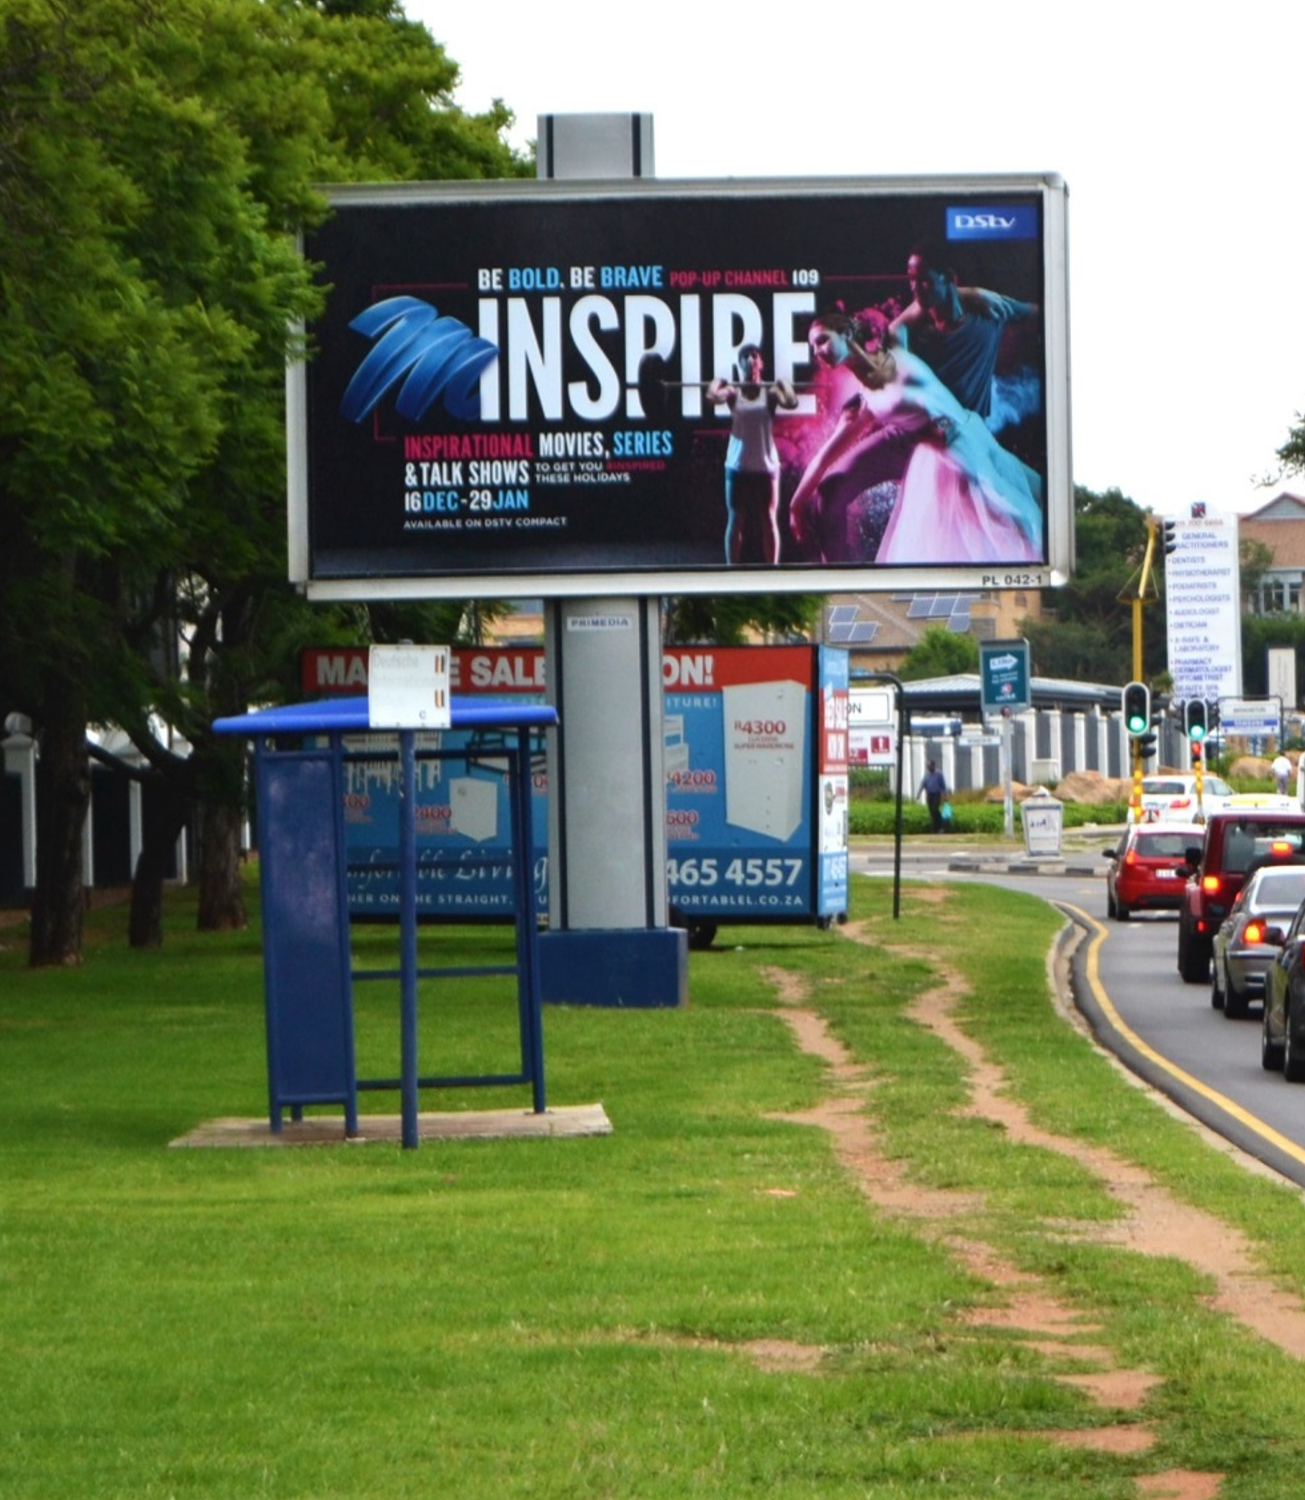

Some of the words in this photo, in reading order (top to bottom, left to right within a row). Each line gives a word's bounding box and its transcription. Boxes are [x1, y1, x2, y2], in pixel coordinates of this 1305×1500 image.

[478, 267, 503, 291] BE
[508, 267, 565, 290] BOLD.
[570, 266, 595, 289] BE
[601, 265, 663, 288] BRAVE
[670, 270, 722, 287] POP-UP
[725, 269, 788, 286] CHANNEL
[792, 269, 819, 286] 109
[478, 292, 817, 423] INSPIRE
[404, 434, 534, 460] INSPIRATIONAL
[539, 431, 610, 459] MOVIES,
[613, 430, 673, 456] SERIES
[469, 460, 530, 485] SHOWS
[535, 462, 550, 472] TO
[553, 461, 575, 472] GET
[579, 461, 603, 472] YOU
[535, 473, 570, 483] THESE
[573, 472, 630, 483] HOLIDAYS
[404, 519, 462, 529] AVAILABLE
[465, 519, 481, 528] ON
[484, 518, 512, 527] DSTV
[515, 517, 567, 527] COMPACT
[1176, 541, 1229, 549] RACTITIONERS
[982, 575, 999, 586] PL
[1004, 574, 1042, 586] 042-1
[570, 618, 629, 628] PRIMEDIA
[666, 697, 717, 708] ITURE!
[734, 720, 786, 735] R4300
[667, 771, 714, 786] 4200
[413, 807, 452, 820] 2400
[725, 858, 803, 886] 4557
[414, 895, 431, 905] HE
[671, 895, 803, 906] FORTABLEL.CO.ZA
